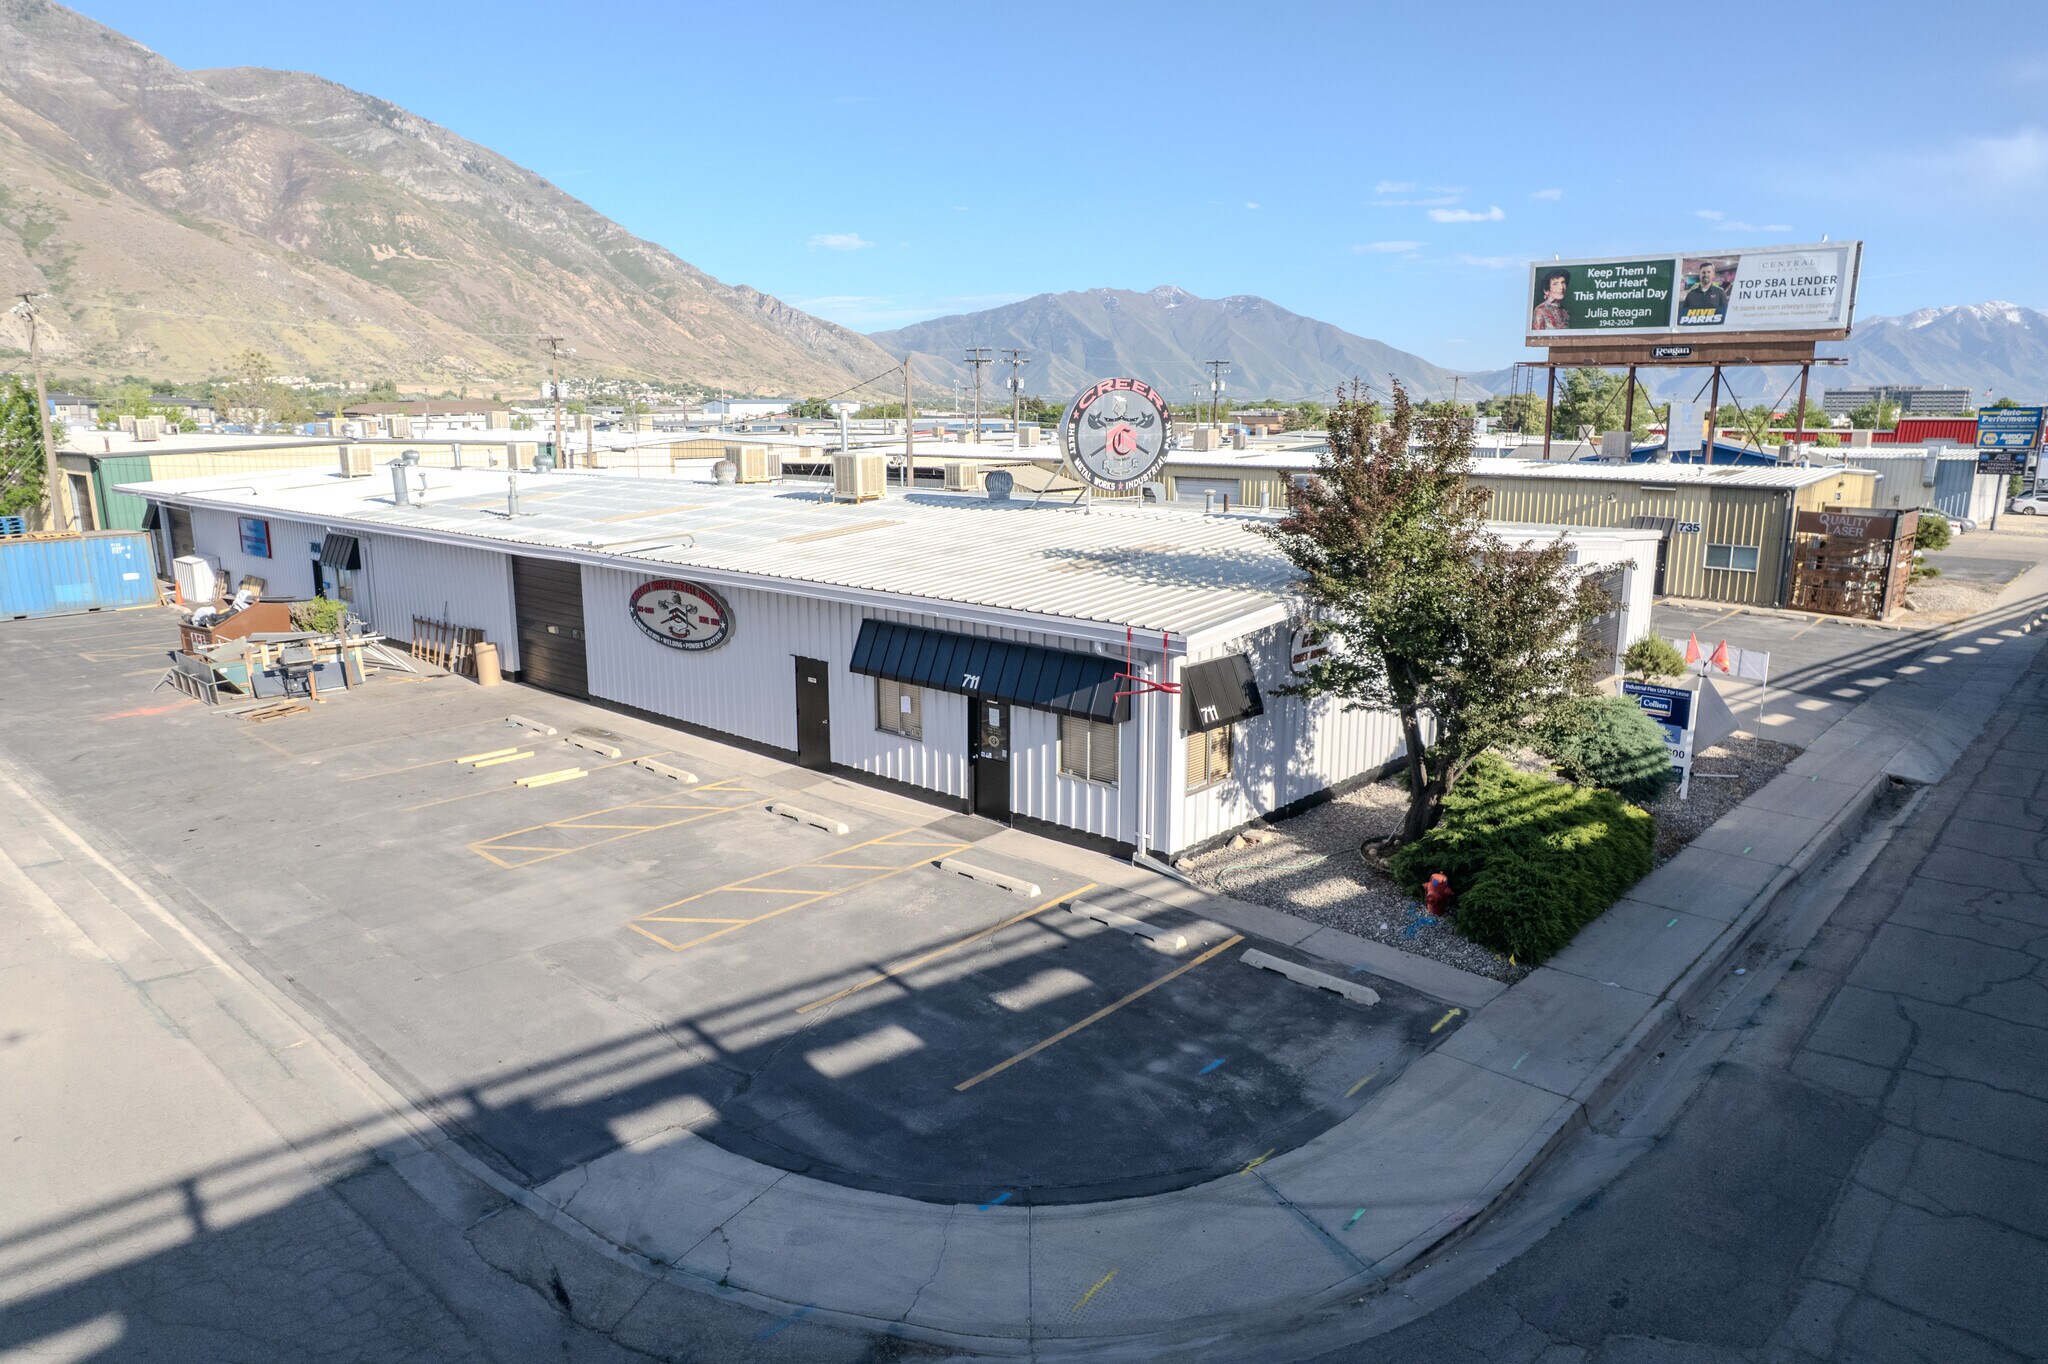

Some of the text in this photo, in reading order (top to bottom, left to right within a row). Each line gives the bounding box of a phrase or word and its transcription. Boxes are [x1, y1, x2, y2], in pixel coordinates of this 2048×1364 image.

[1762, 259, 1816, 269] CENTRAL
[1587, 265, 1657, 279] Keep Them In
[1594, 278, 1648, 289] Your Heart
[1739, 275, 1838, 289] TOP SBA LENDER
[1574, 288, 1668, 301] This Memorial Day
[1739, 286, 1835, 300] IN UTAH VALLEY
[1687, 308, 1716, 316] HIVE
[1781, 303, 1804, 311] always
[1585, 307, 1652, 320] Julia Reagan
[1680, 314, 1723, 324] PARKS
[1599, 319, 1634, 327] 1942-2024
[1655, 346, 1690, 356] Reagan
[1078, 378, 1164, 411] CREER
[1981, 415, 2038, 423] Performance
[1068, 422, 1116, 491] SHEET METAL WORKS
[1125, 421, 1172, 489] INDUSTRIAL PARK
[1820, 513, 1872, 528] QUALITY
[1679, 523, 1700, 533] 735
[1825, 525, 1864, 537] LASER
[962, 673, 980, 689] 711
[1625, 683, 1647, 691] Industrial
[1643, 699, 1668, 709] Colliers
[1200, 704, 1219, 723] 711
